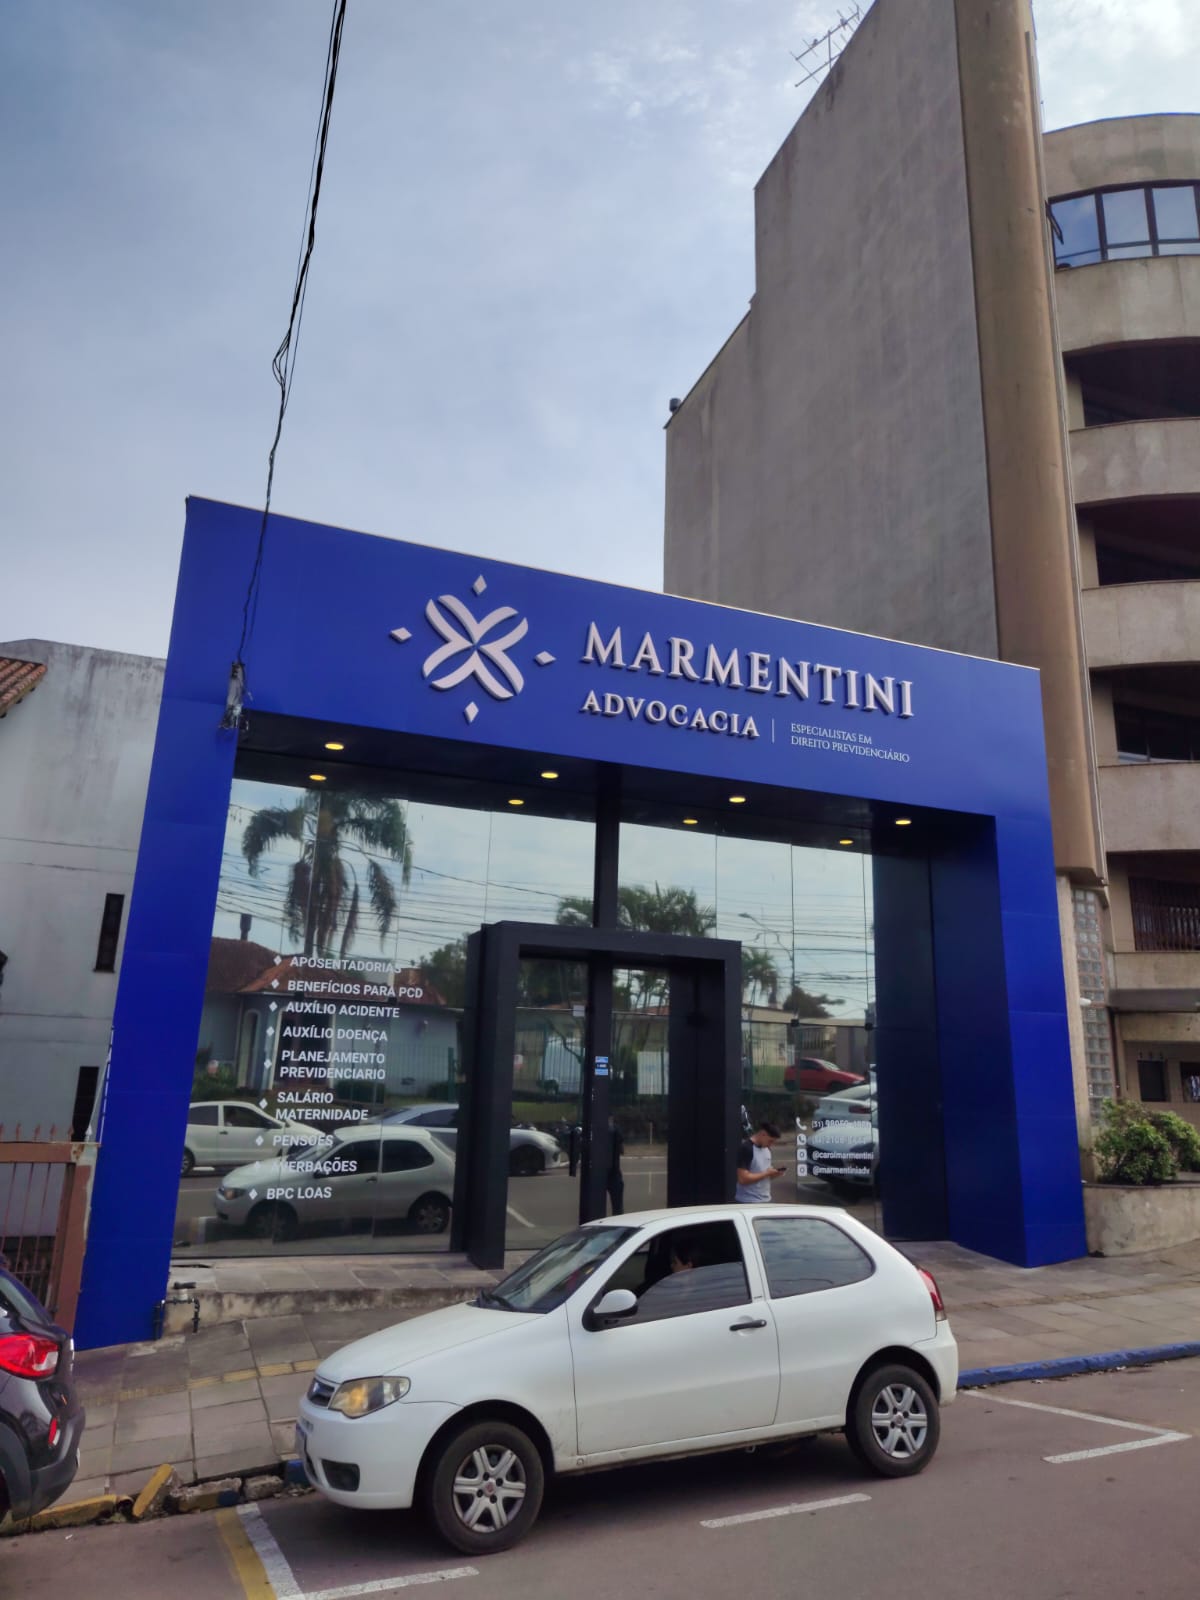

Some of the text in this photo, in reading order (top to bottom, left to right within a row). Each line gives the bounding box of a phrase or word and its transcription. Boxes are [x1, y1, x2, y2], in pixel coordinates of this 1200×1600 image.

[580, 621, 914, 718] MARMENTINI
[580, 689, 760, 737] ADVOCACIA
[791, 723, 873, 745] ESPECIALISTAS EM
[791, 736, 910, 763] DIREITO PREVIDENCIÁRIO
[289, 956, 402, 974] APOSENTADORIAS
[287, 979, 424, 999] BENEFÍCIOS PARA PCD
[285, 1000, 401, 1018] AUXÍLIO ACIDENTE
[282, 1024, 388, 1043] AUXÍLIO DOENÇA
[281, 1050, 386, 1065] PLANEJAMENTO
[279, 1066, 387, 1080] PREVIDENCIARIO
[276, 1088, 334, 1104] SALÁRIO
[275, 1108, 369, 1121] MATERNIDADE
[271, 1156, 358, 1175] VERBAÇÕES
[266, 1187, 333, 1200] BPC LOAS
